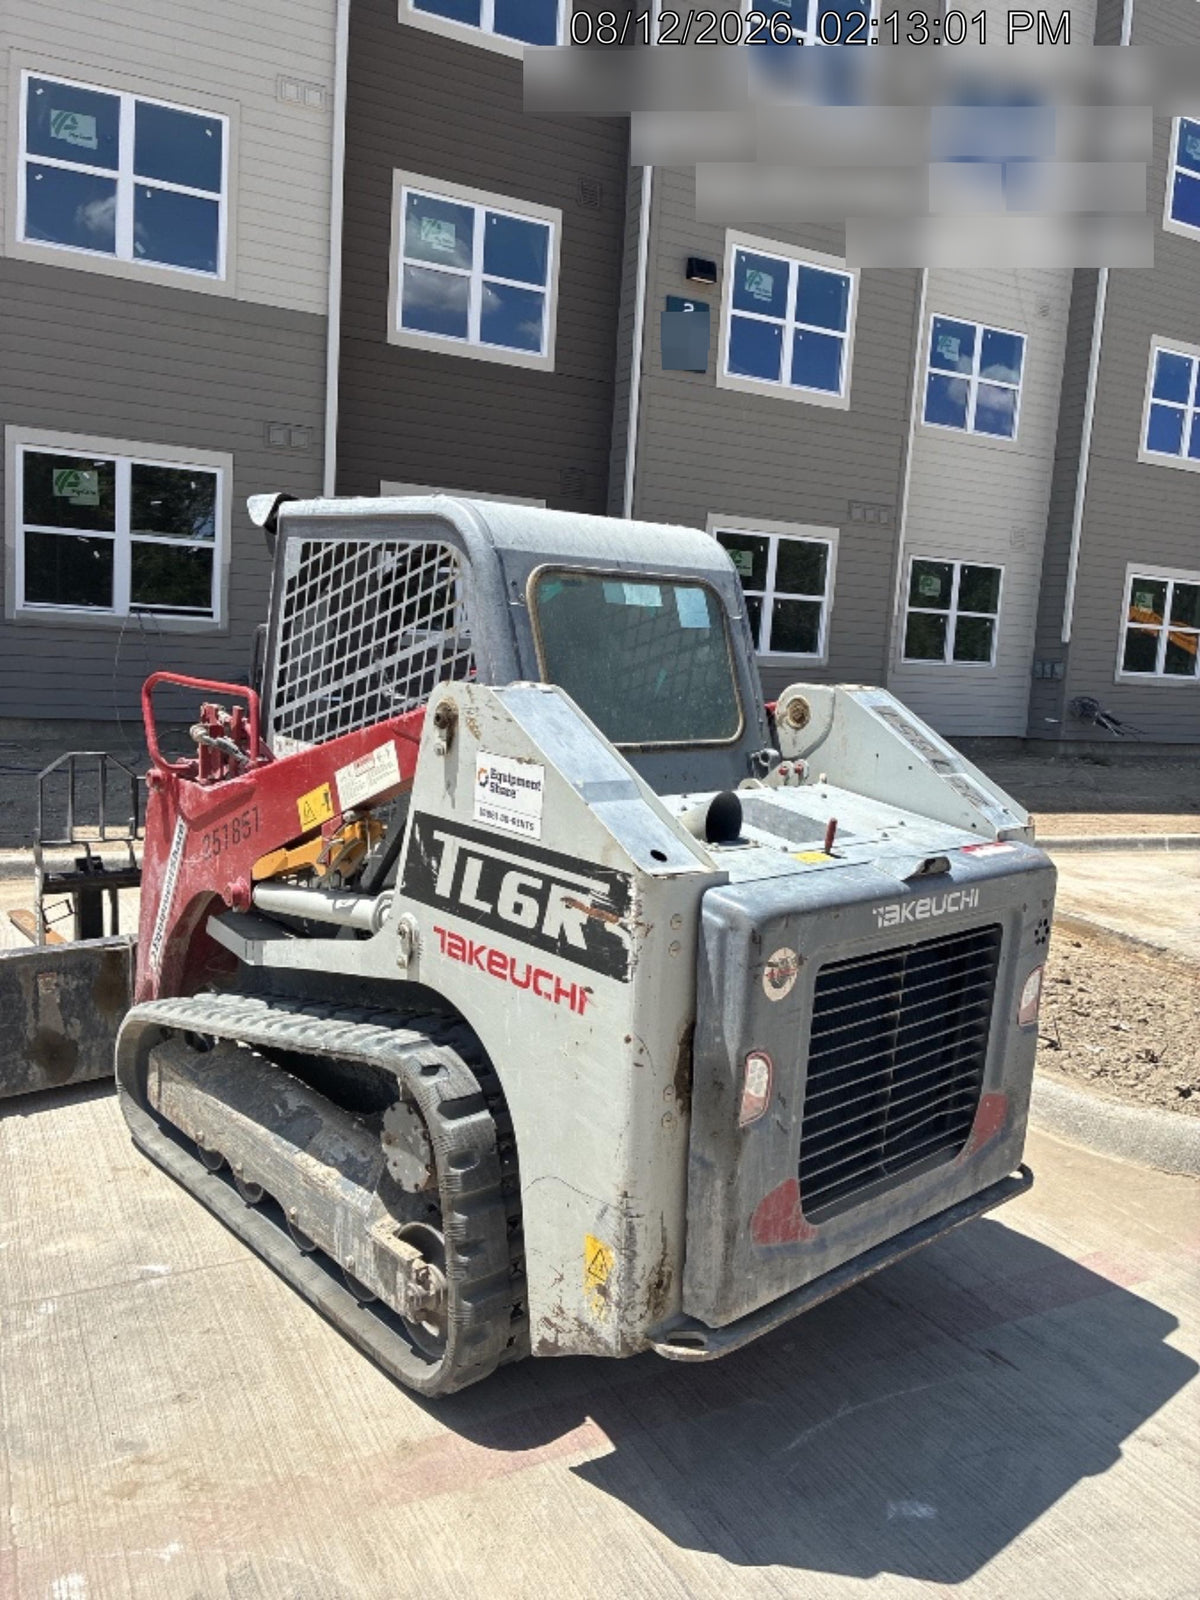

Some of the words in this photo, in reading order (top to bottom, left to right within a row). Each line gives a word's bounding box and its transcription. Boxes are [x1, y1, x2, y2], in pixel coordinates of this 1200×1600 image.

[490, 767, 541, 792] Equipment
[872, 887, 980, 928] TAKEUCHI
[433, 925, 592, 1016] TAKEUCHI
